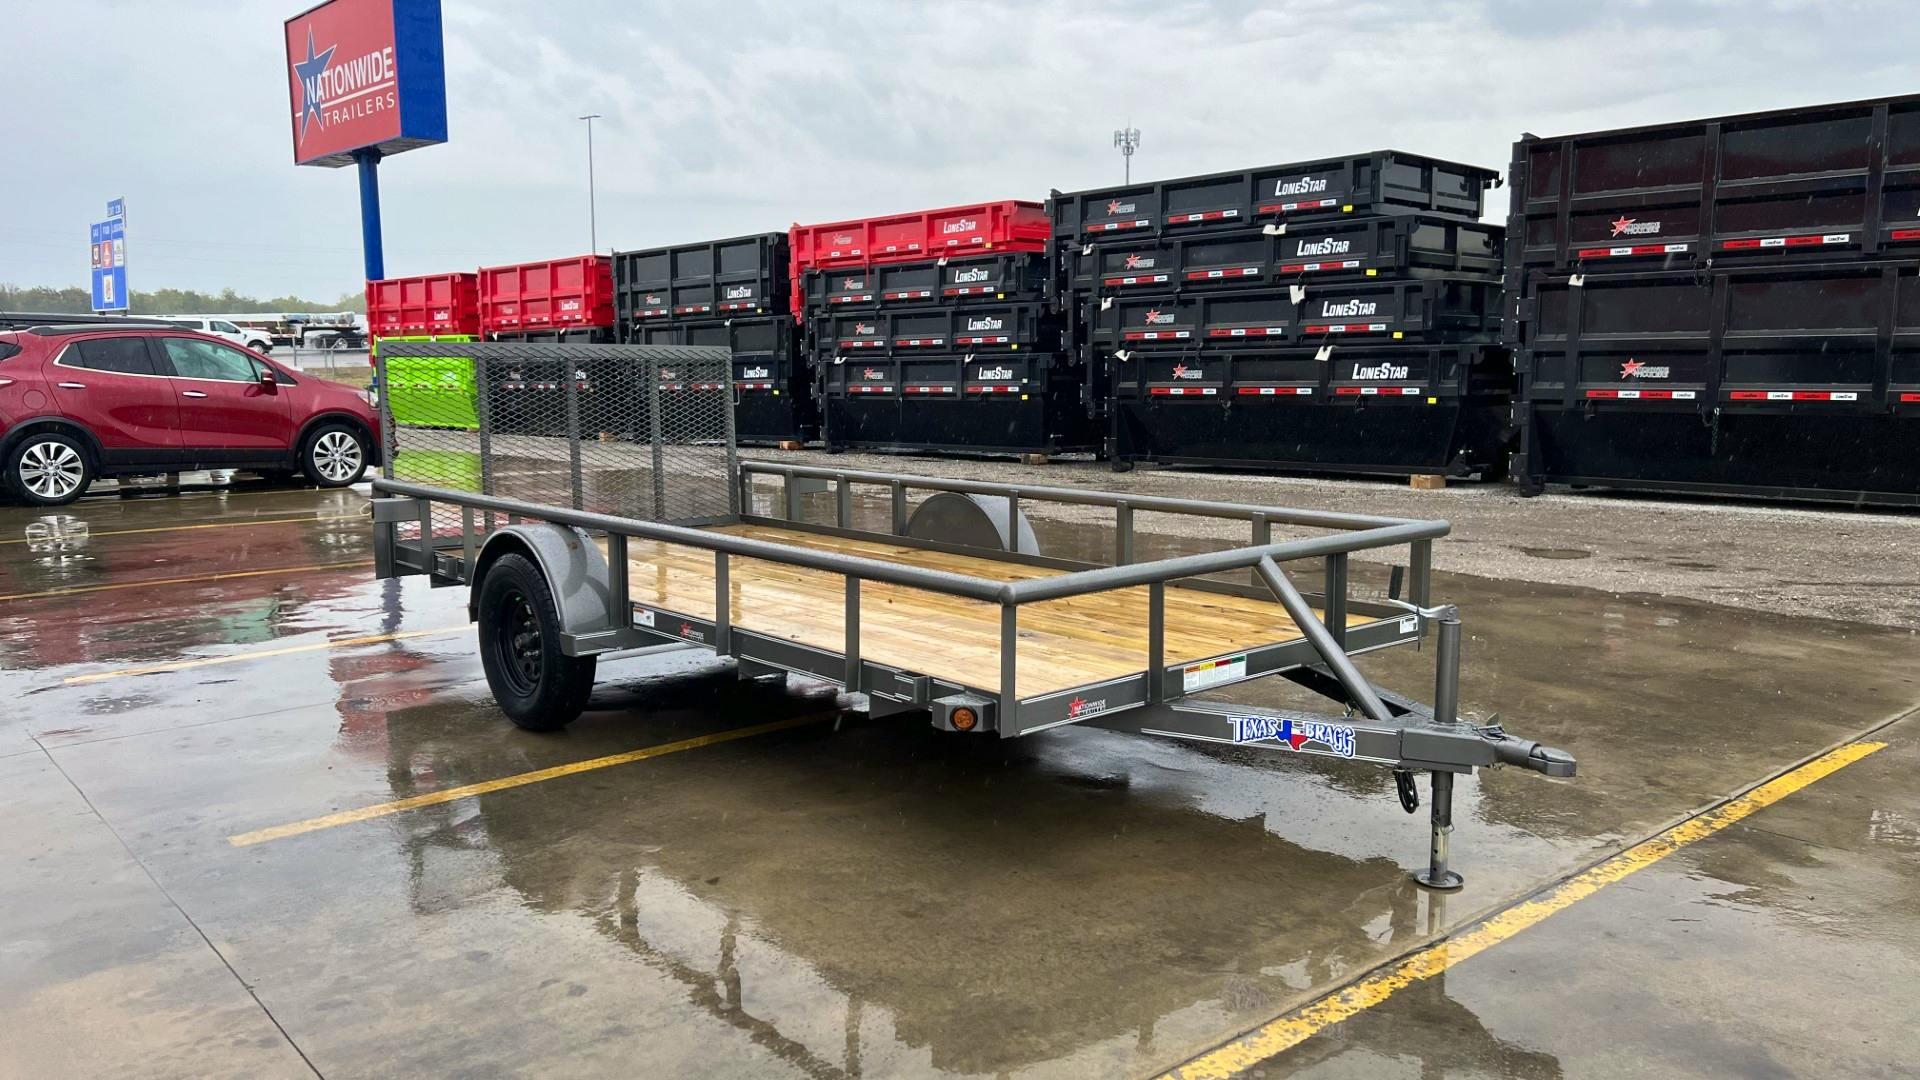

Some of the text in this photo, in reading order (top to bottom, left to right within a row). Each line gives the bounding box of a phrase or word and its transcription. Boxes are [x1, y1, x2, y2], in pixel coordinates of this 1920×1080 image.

[306, 46, 394, 106] NATIONWIDE
[323, 92, 395, 127] TRAILERS
[1274, 176, 1327, 196] LONESTAR
[1296, 237, 1350, 256] LONESTAR
[1322, 299, 1377, 317] LONESTAR
[1351, 362, 1409, 380] LONESTAR
[1227, 715, 1356, 758] TEXAS BRAGG
